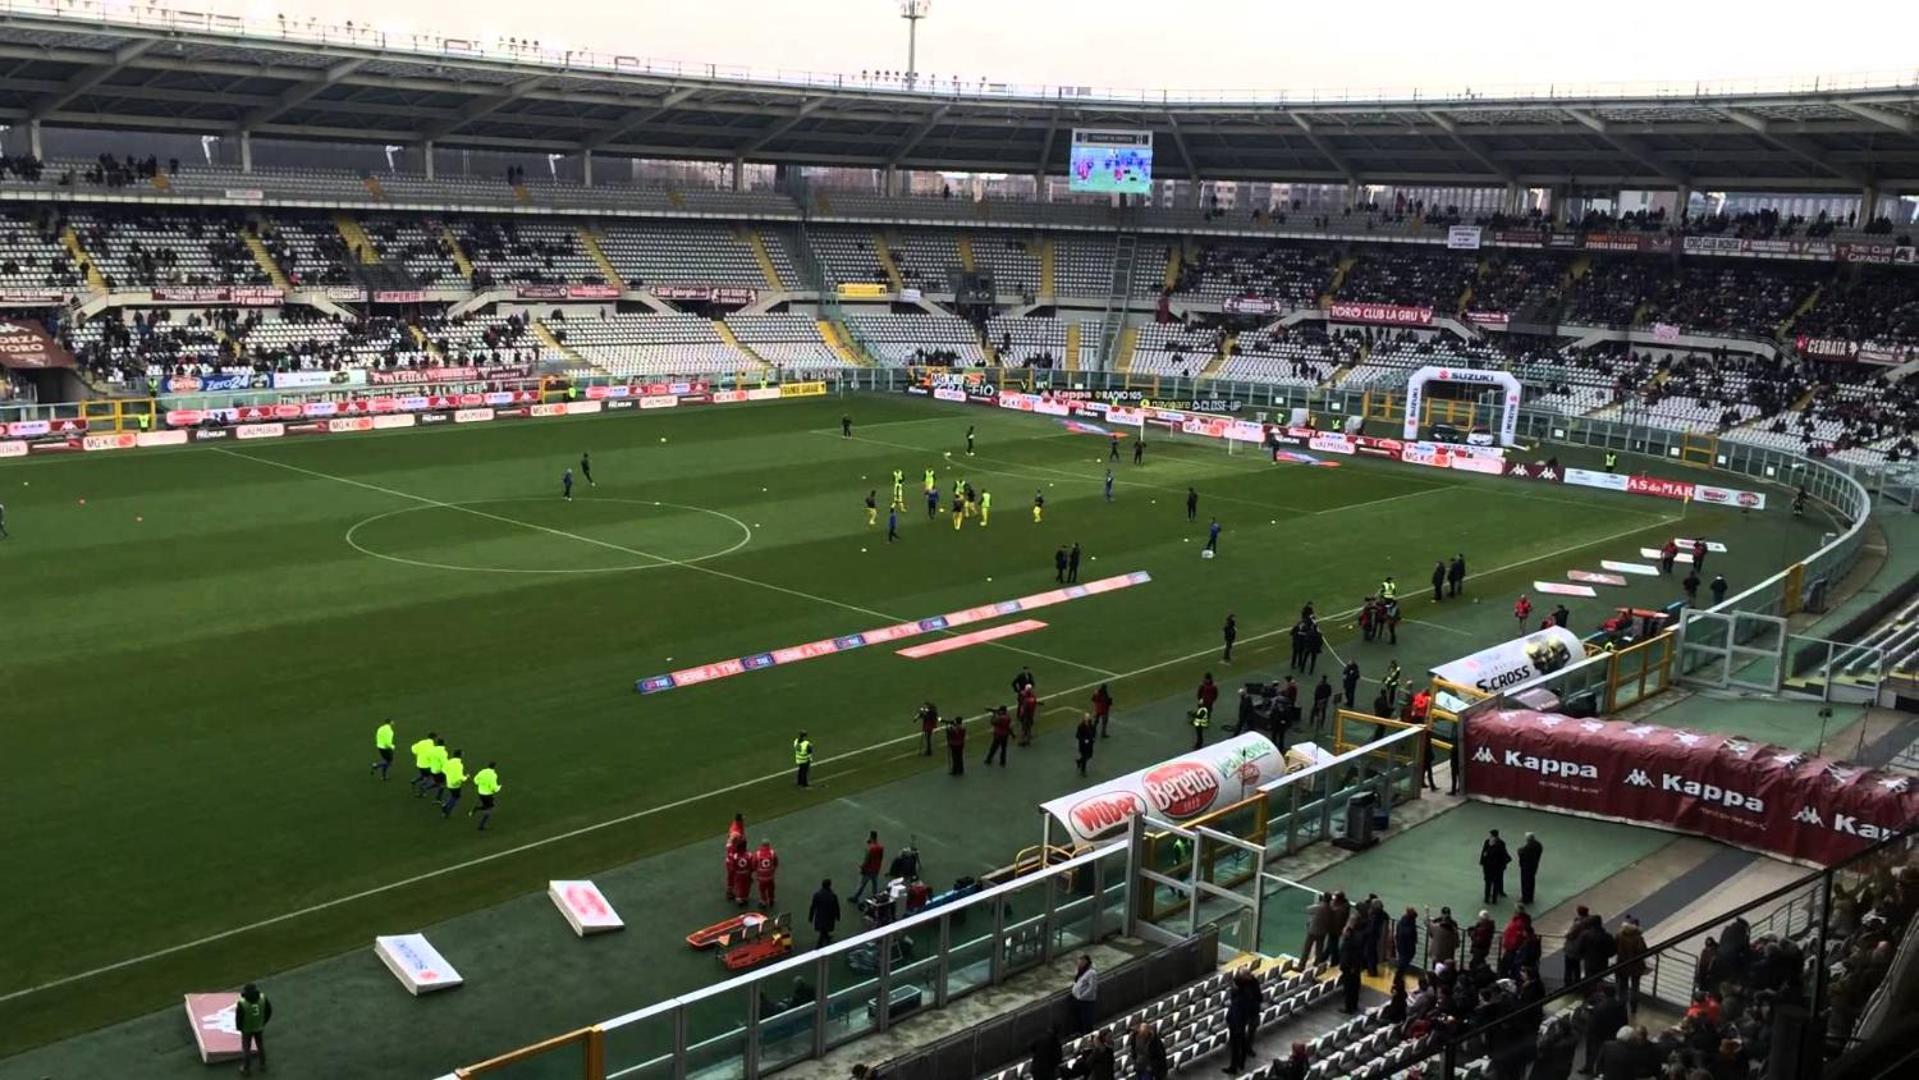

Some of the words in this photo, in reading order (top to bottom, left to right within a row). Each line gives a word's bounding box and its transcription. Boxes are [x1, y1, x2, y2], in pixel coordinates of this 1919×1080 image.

[1331, 305, 1361, 318] TORO
[1363, 307, 1385, 319] CLUB
[1386, 309, 1397, 320] LA
[1399, 310, 1418, 321] GRU
[0, 335, 44, 344] ORZA
[1451, 371, 1495, 381] SUZUKI
[1053, 391, 1093, 400] Kappa
[1410, 387, 1419, 417] SUZUKI
[1628, 479, 1648, 490] AS
[1662, 483, 1694, 496] MAR
[1476, 664, 1531, 692] S-CROSS
[1505, 750, 1599, 779] Kappa
[1073, 794, 1138, 833] Wüber
[1144, 764, 1216, 811] Beretta
[1662, 773, 1765, 813] Kappa
